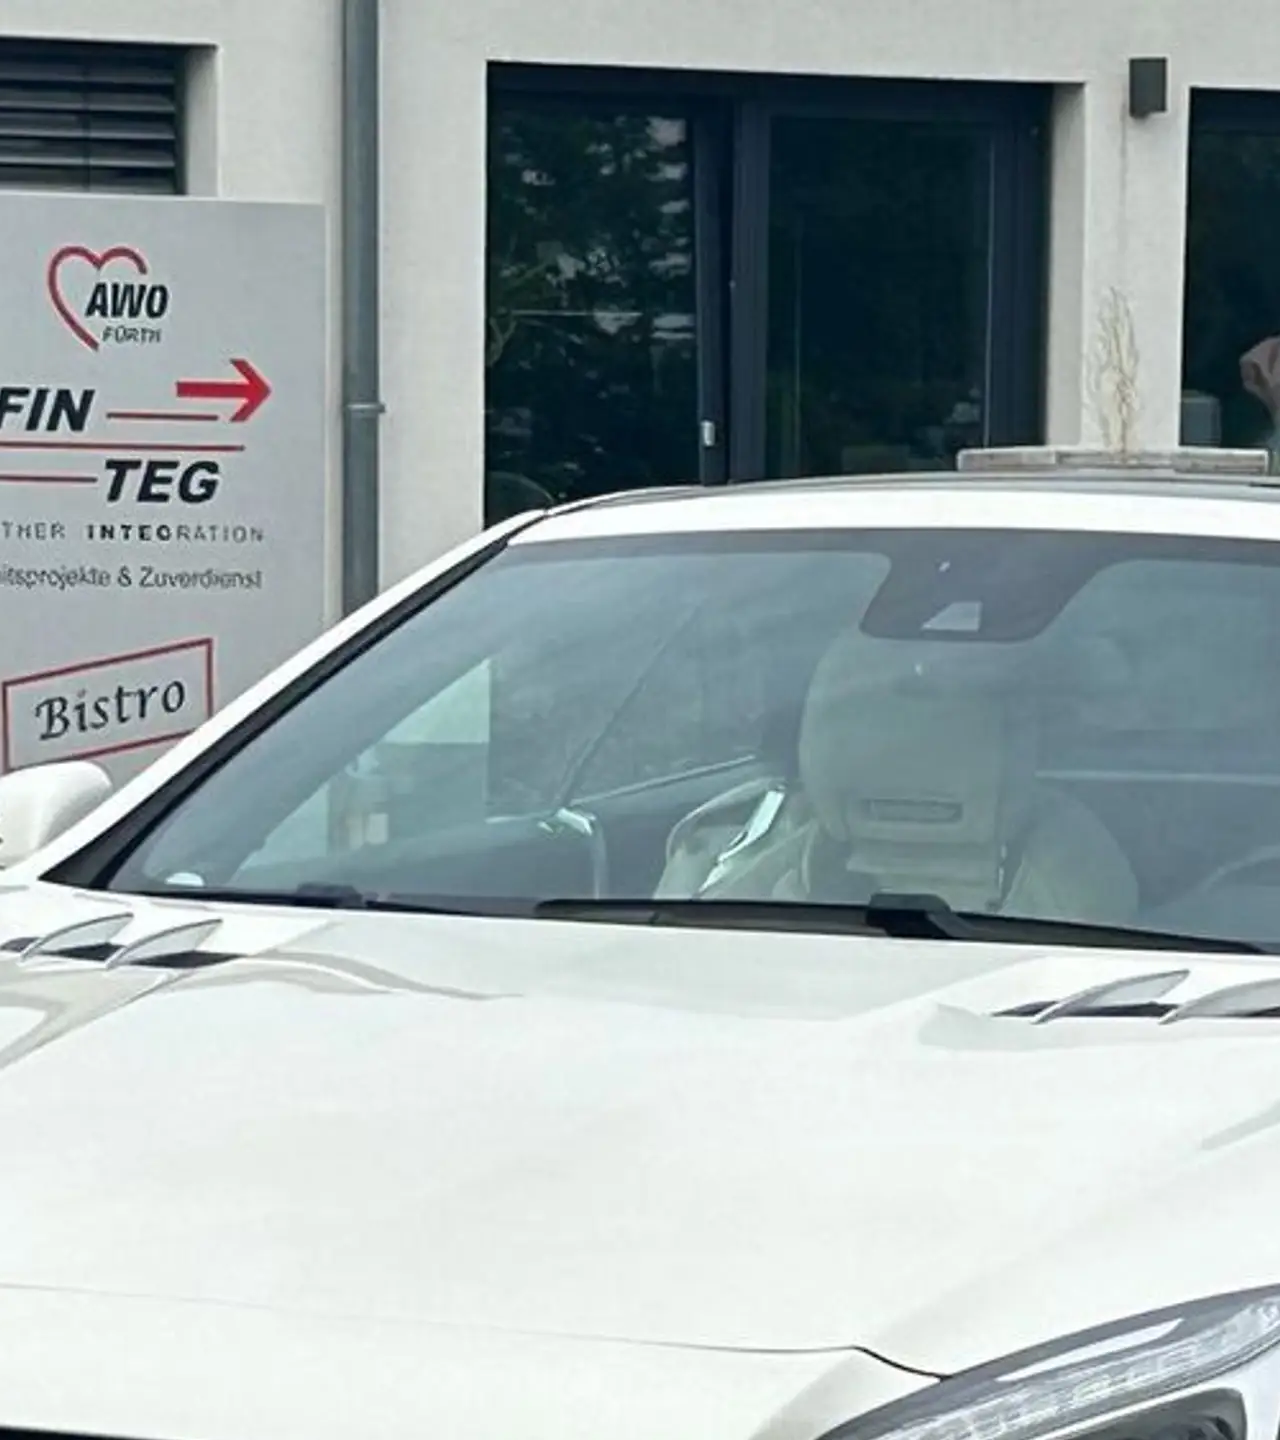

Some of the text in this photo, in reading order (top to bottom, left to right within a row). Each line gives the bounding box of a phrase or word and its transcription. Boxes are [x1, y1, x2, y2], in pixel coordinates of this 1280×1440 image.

[85, 282, 169, 319] AWO
[105, 458, 220, 504] TEG
[85, 523, 265, 544] INTEGRATION
[117, 564, 132, 588] &
[138, 565, 263, 590] Zuverdienst
[34, 680, 187, 740] Bistro
